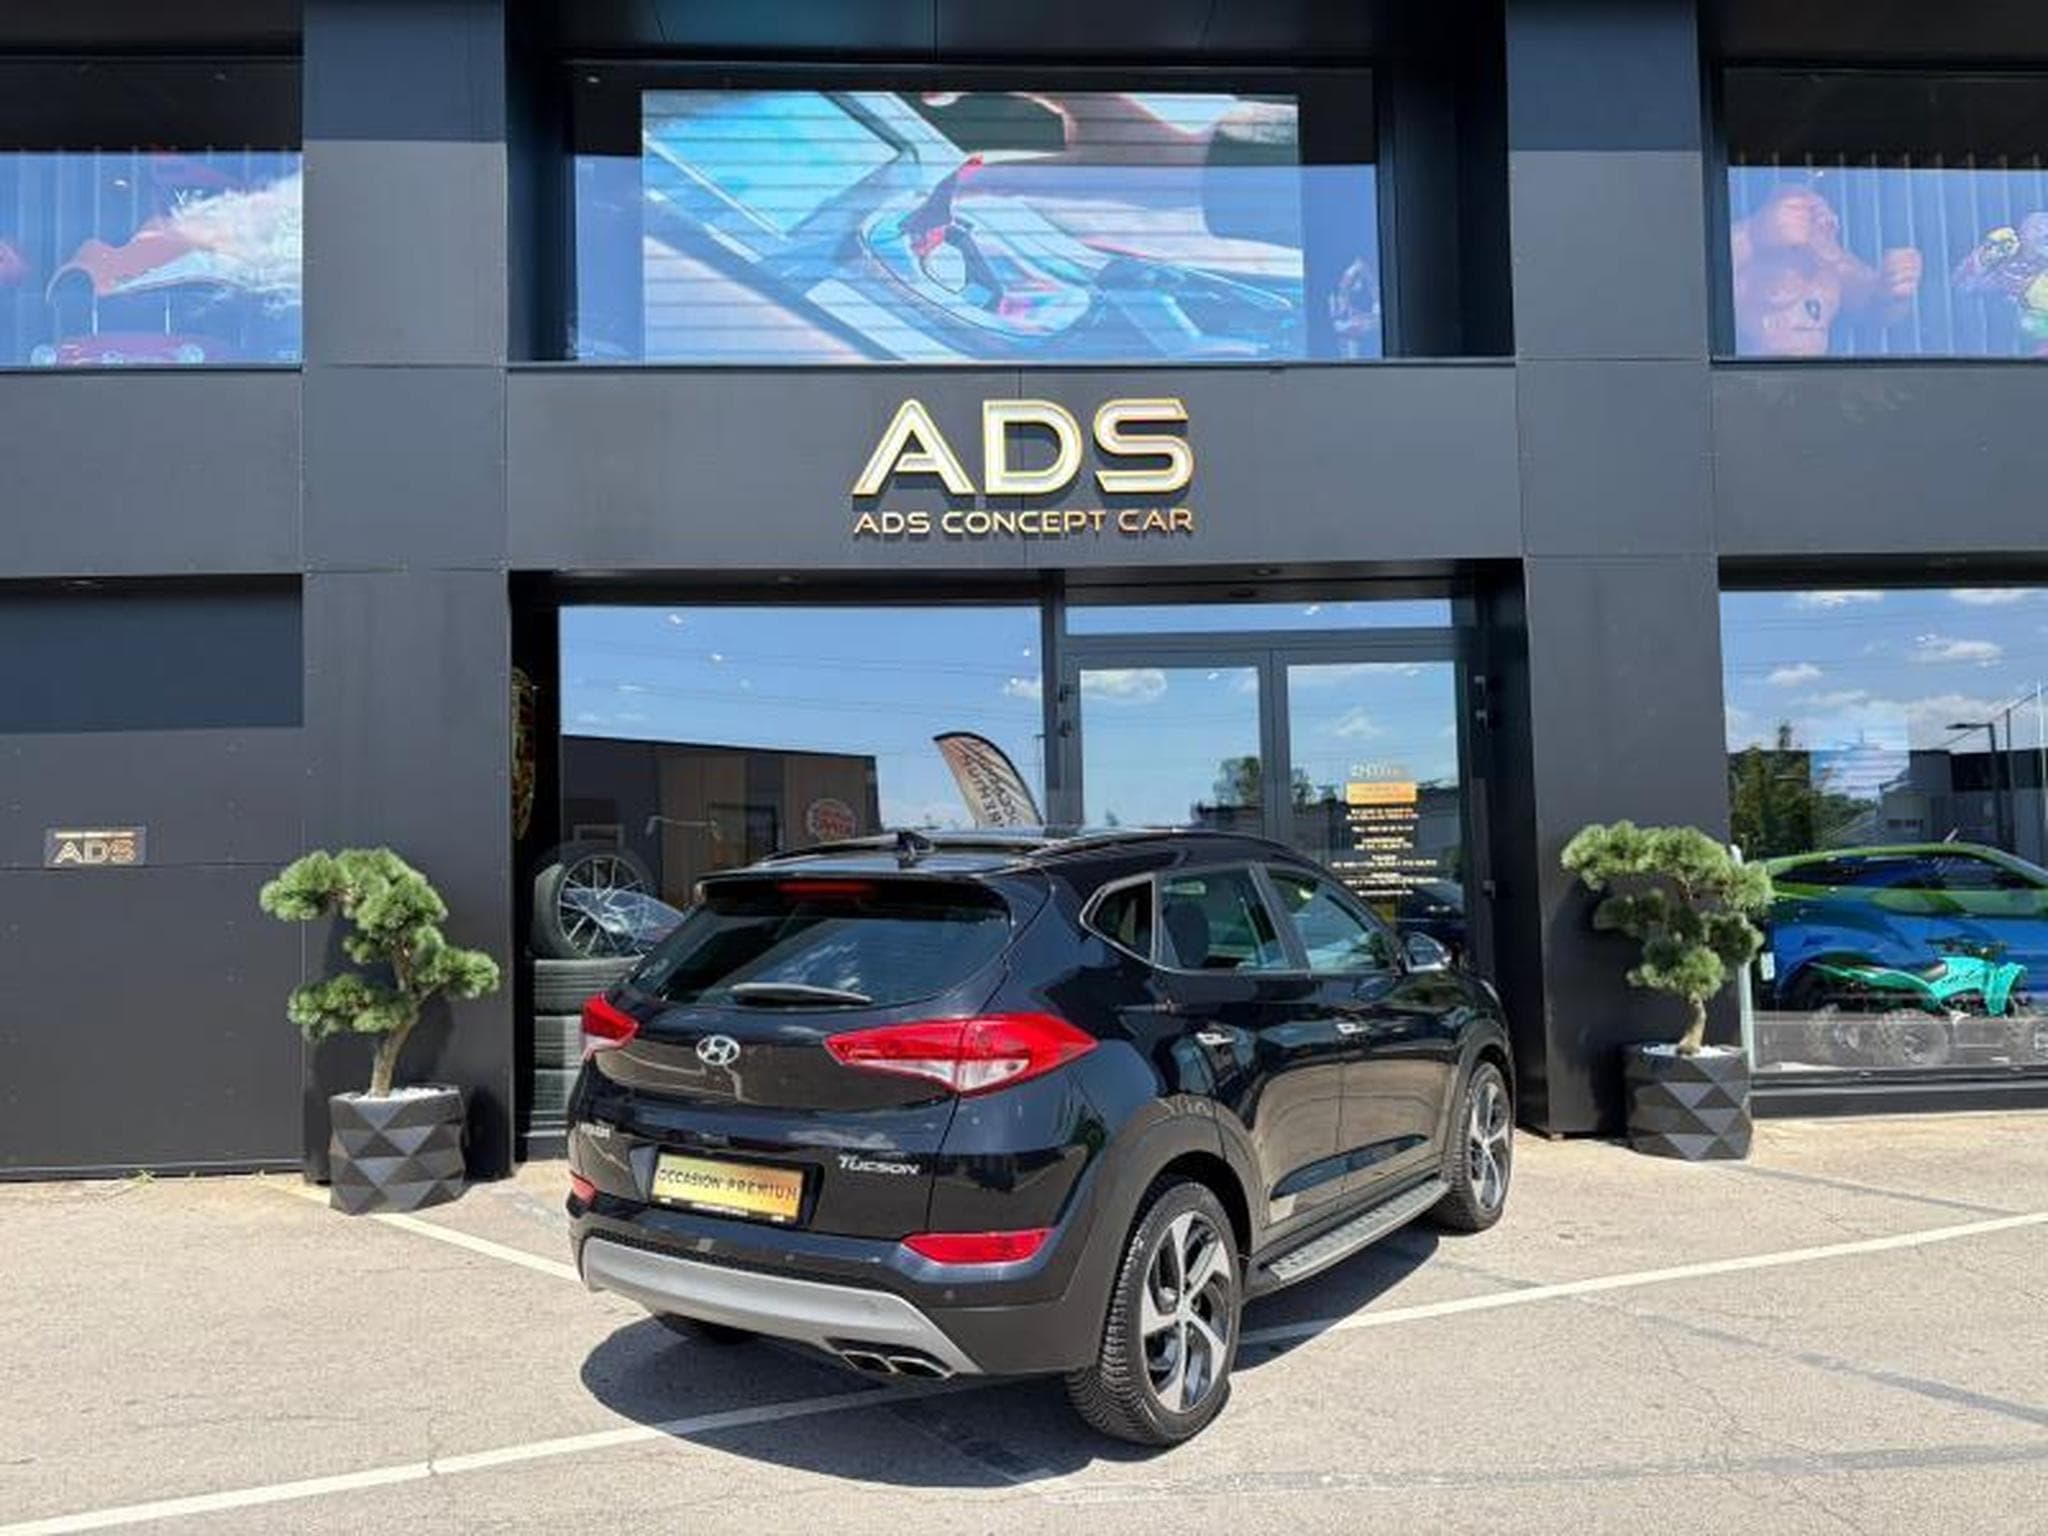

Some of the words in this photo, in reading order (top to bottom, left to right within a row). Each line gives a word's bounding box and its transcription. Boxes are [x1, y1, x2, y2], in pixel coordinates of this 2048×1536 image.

[852, 398, 1194, 495] ADS
[854, 511, 931, 534] ADS
[942, 510, 1106, 533] CONCEPT
[1117, 509, 1194, 532] CAR
[52, 838, 136, 865] ADS
[838, 1154, 920, 1175] TUCSON
[657, 1167, 721, 1190] OCCASION
[726, 1178, 798, 1200] PREMIUM
